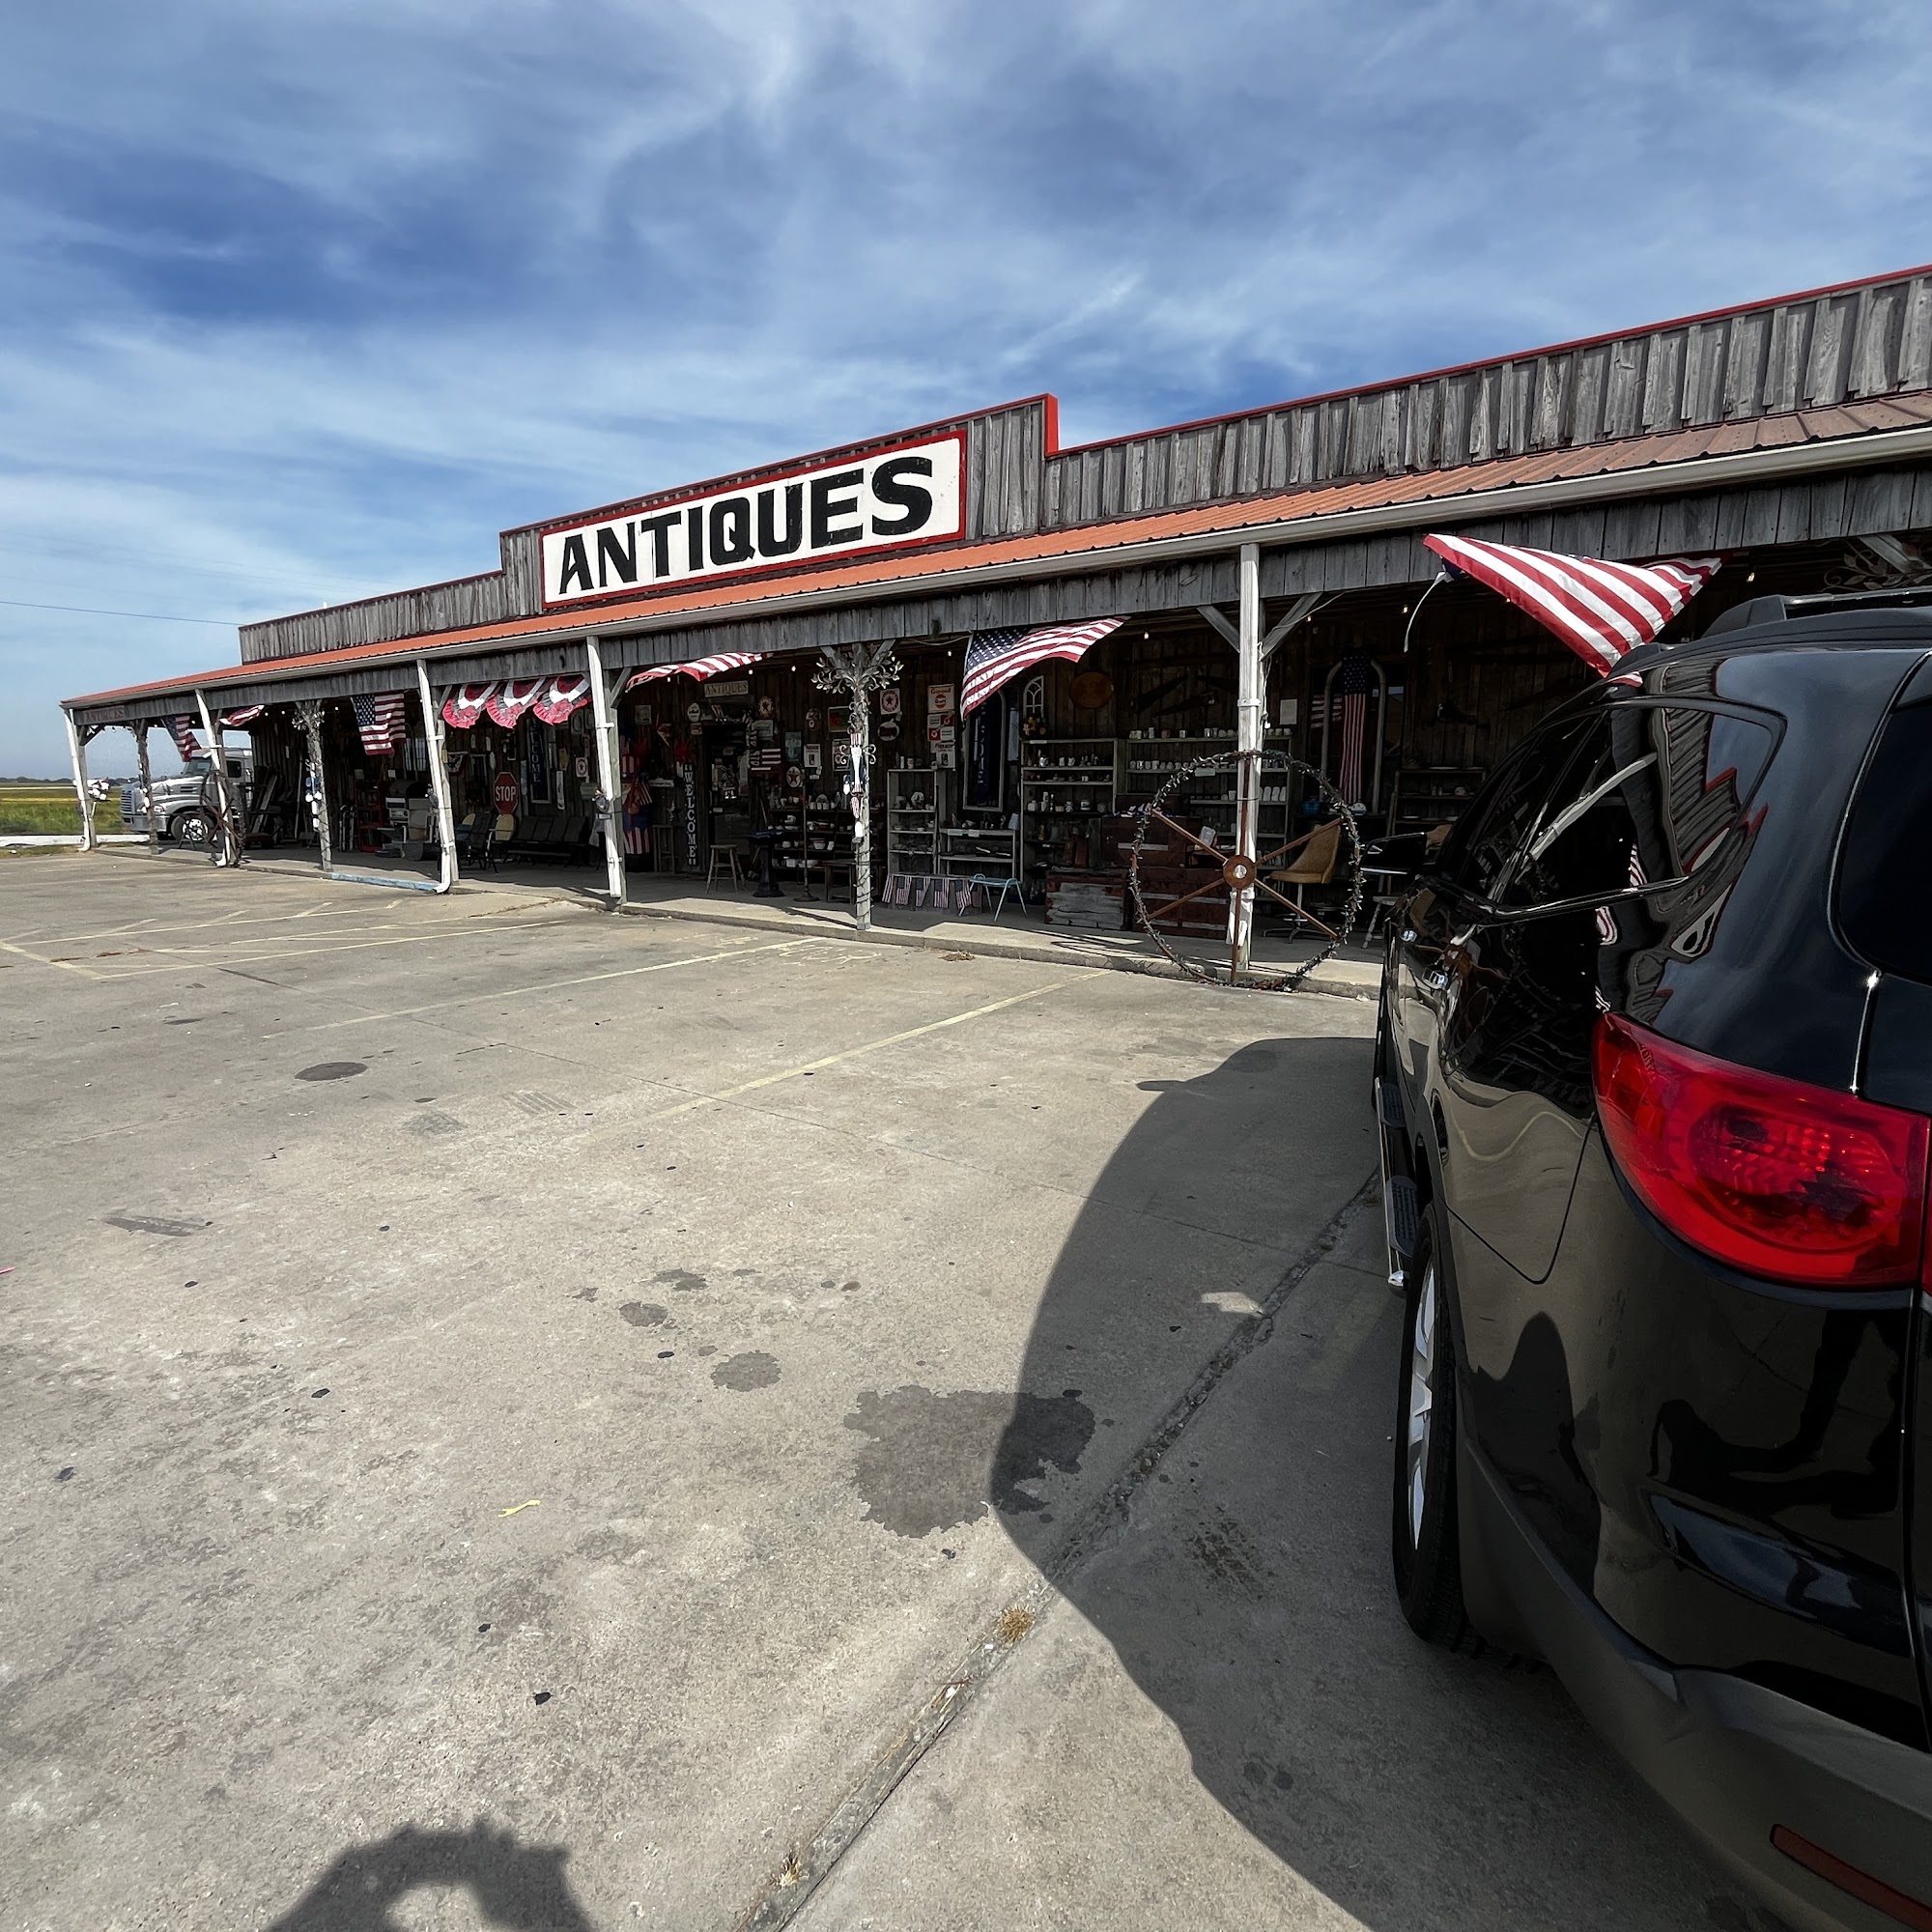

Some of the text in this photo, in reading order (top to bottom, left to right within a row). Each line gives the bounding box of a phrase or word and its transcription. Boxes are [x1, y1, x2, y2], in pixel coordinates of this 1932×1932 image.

[559, 457, 933, 595] ANTIQUES
[706, 682, 748, 695] ANTIQUES
[496, 785, 516, 802] STOP
